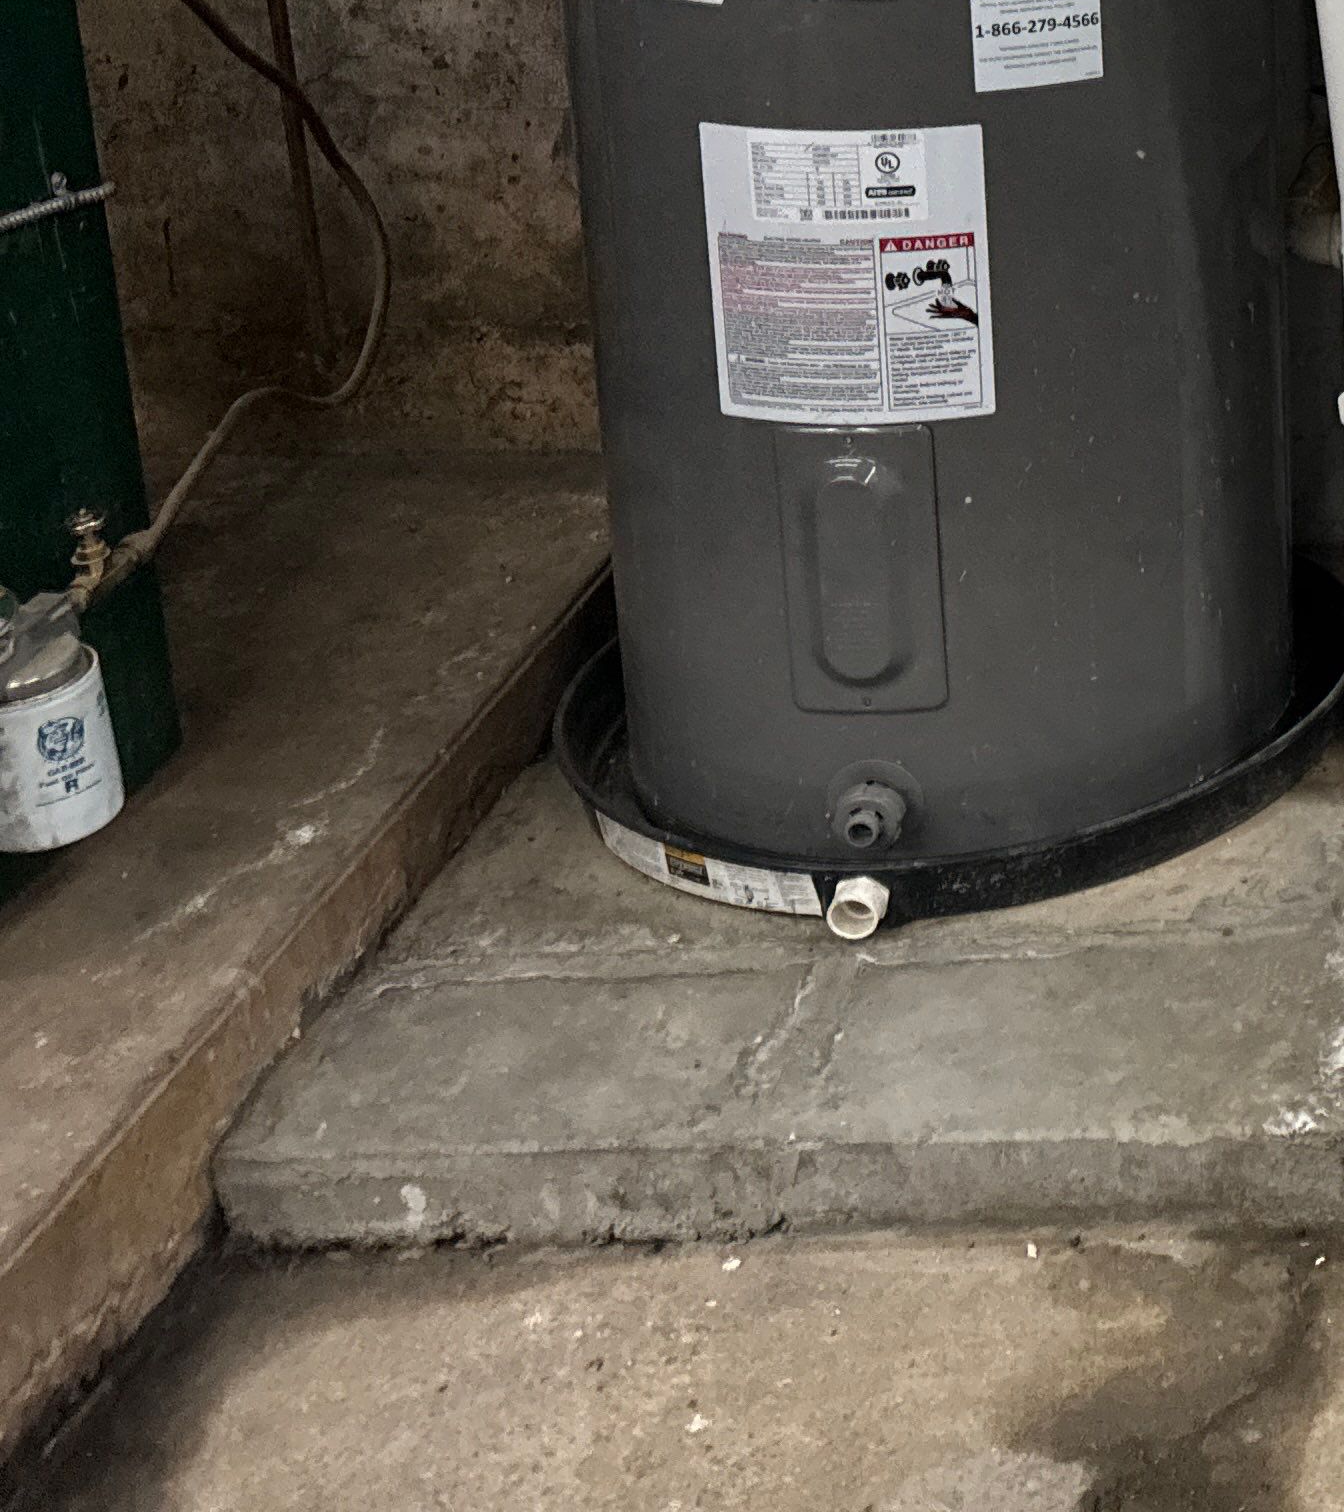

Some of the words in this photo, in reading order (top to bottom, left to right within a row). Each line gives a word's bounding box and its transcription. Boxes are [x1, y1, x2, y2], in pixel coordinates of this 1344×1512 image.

[975, 11, 1099, 38] 1-866-279-4566
[880, 156, 895, 169] UL
[902, 236, 969, 250] DANGER
